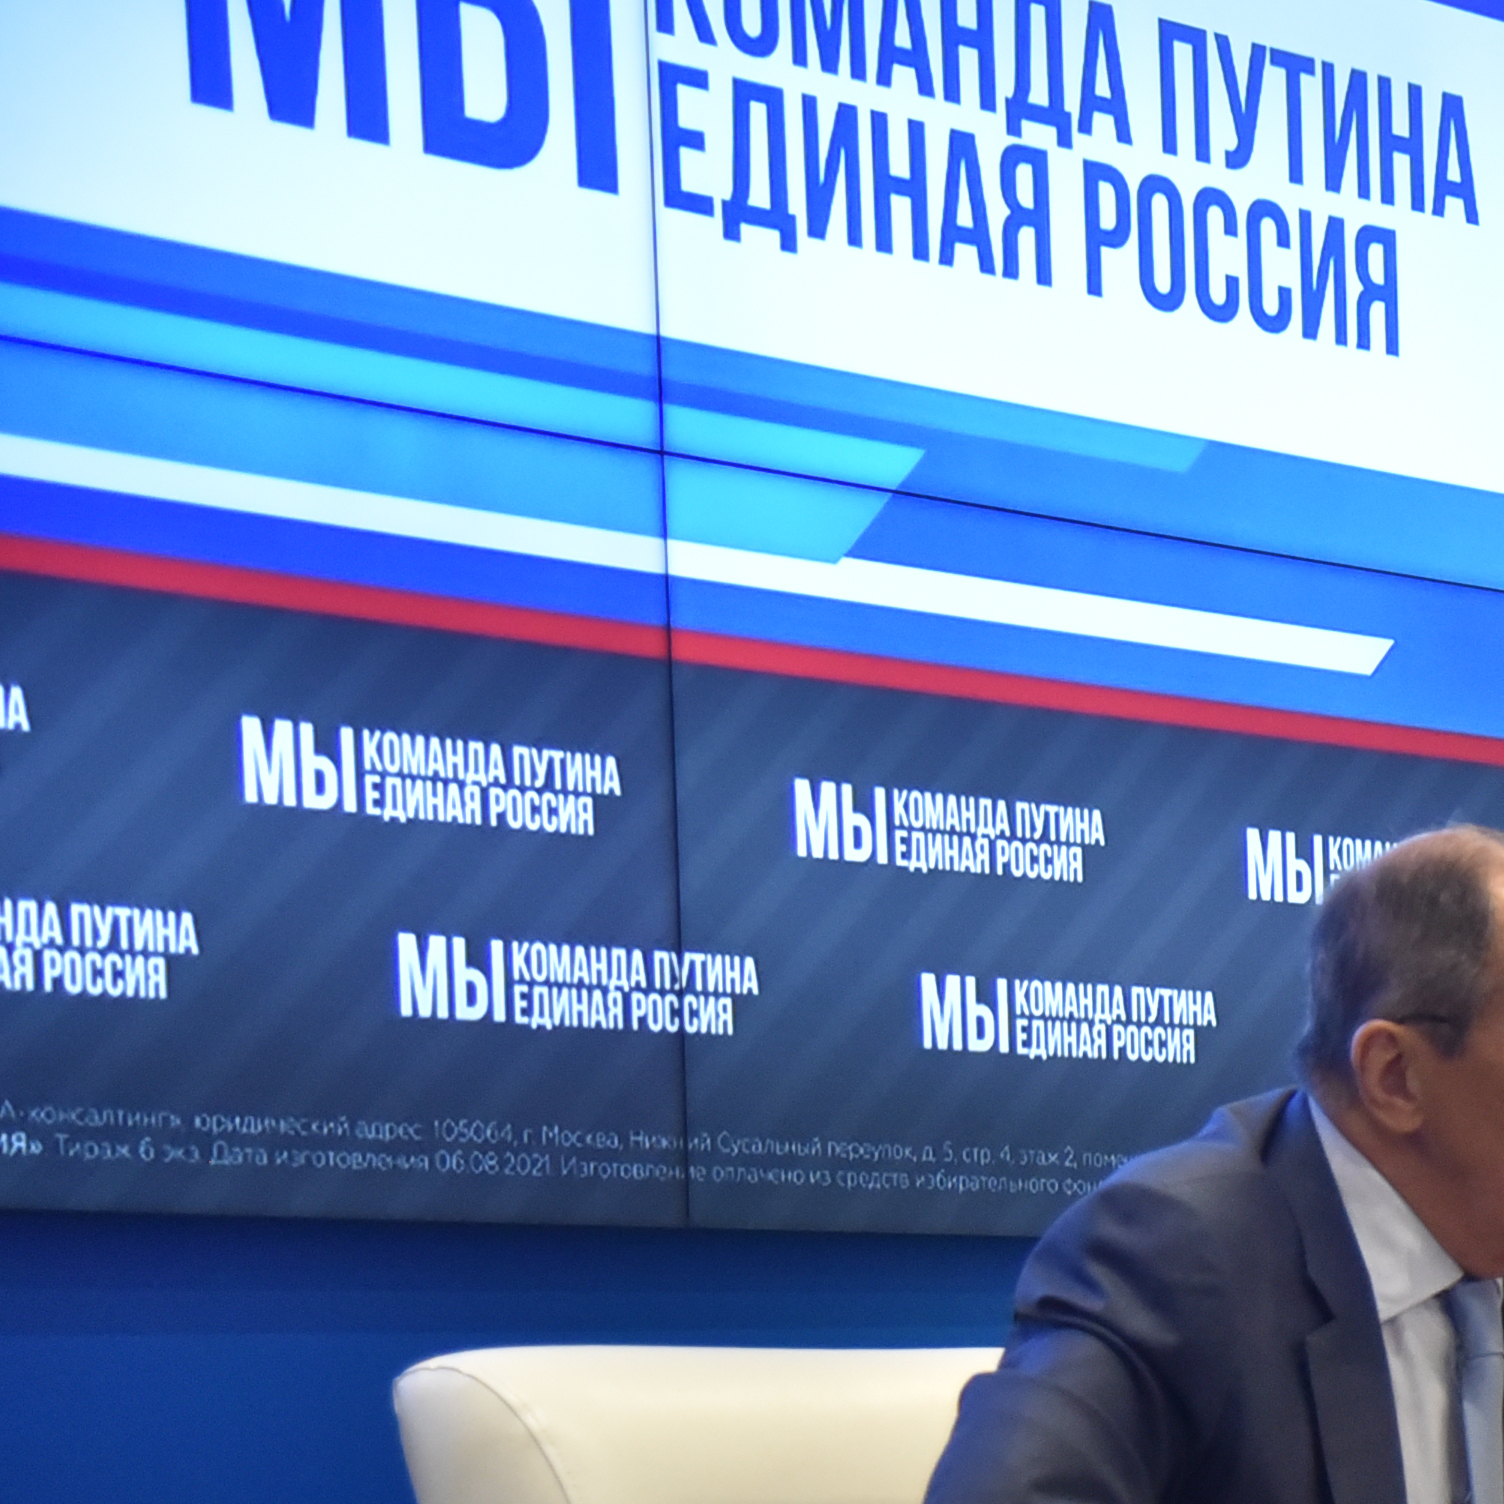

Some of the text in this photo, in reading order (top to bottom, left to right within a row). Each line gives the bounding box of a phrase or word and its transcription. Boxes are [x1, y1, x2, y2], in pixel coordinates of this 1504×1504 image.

[655, 0, 1480, 227] МАНДА ПУТИНА
[657, 58, 1401, 358] ЕДИНАЯ РОССИЯ
[241, 715, 358, 813] МЫ
[362, 729, 621, 797] КОМАНДА ПУТИНА
[364, 774, 594, 836] ЕДИНАЯ РОССИЯ
[794, 778, 889, 865] МЫ
[893, 788, 1105, 847] КОМАНДА ПУТИНА
[894, 829, 1083, 883] ЕДИНАЯ РОССИЯ
[1246, 827, 1325, 905] МЫ
[70, 902, 200, 956] ПУТИНА
[43, 948, 168, 999] РОССИЯ
[397, 932, 506, 1022] МЫ
[511, 940, 760, 996] КОМАНДА ПУТИНА
[513, 984, 733, 1036] ЕДИНАЯ РОССИЯ
[920, 972, 1010, 1054] МЫ
[1014, 978, 1217, 1027] КОМАНДА ПУТИНА
[1015, 1018, 1196, 1065] ЕДИНАЯ РОССИЯ
[54, 1133, 131, 1161] Тираж
[139, 1136, 155, 1162] 6
[209, 1140, 268, 1166] Дата
[275, 1148, 429, 1172] изготовления
[561, 1154, 707, 1182] Изготовление
[712, 1166, 802, 1185] оплачено
[809, 1169, 832, 1186] из
[836, 1169, 910, 1191] средств
[915, 1169, 1059, 1194] избирательного
[629, 1129, 712, 1151] Нижний
[716, 1130, 823, 1157] Сусальный
[1019, 1149, 1059, 1168] этаж
